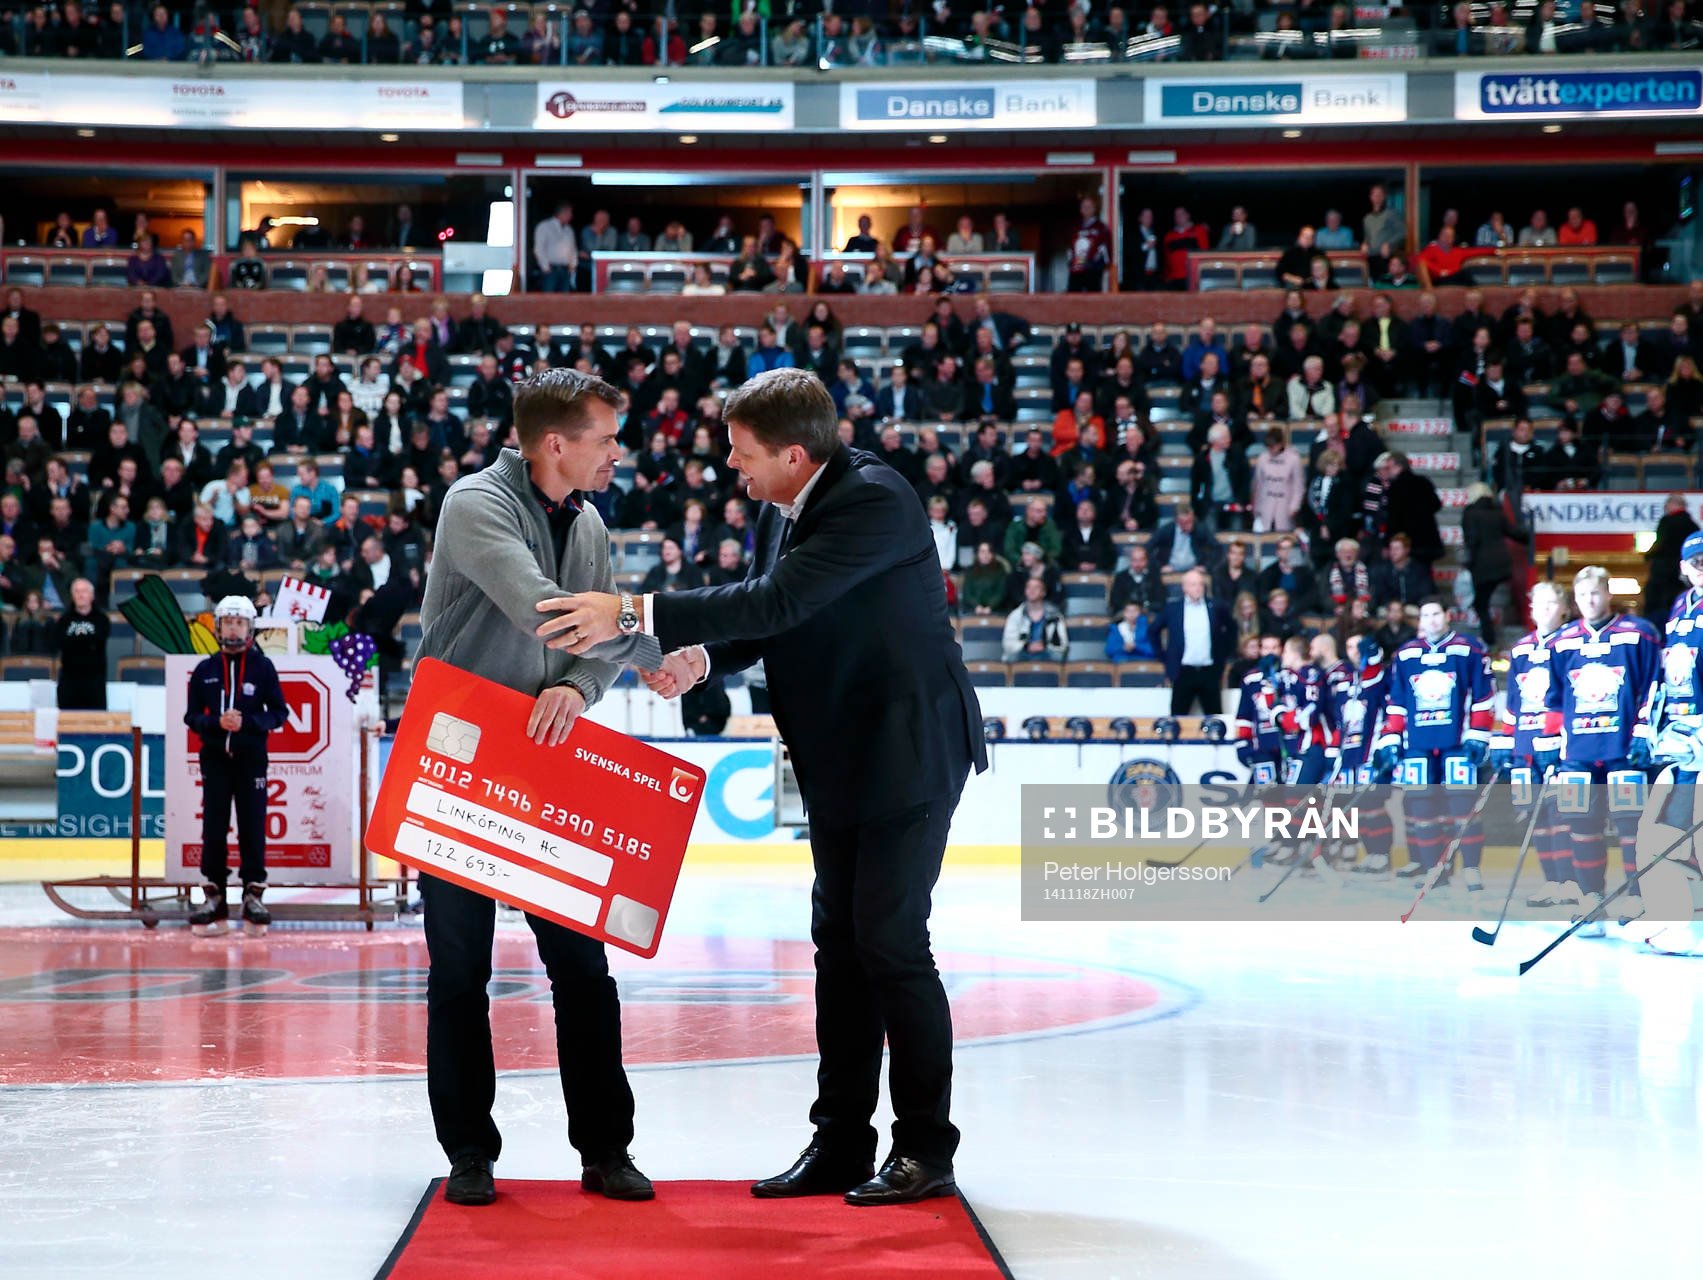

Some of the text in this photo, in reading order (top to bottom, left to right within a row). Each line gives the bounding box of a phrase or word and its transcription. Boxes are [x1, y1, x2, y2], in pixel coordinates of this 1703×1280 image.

[1193, 89, 1379, 113] Danske Bank
[1486, 77, 1696, 109] tvättexperten
[887, 95, 1071, 117] Danske Bank
[1531, 498, 1662, 523] ANDBÄCKE
[574, 747, 662, 793] SVENSKA SPEL
[418, 754, 653, 862] 4012 7496 2390 5185
[426, 838, 457, 862] 122
[540, 840, 561, 859] HC
